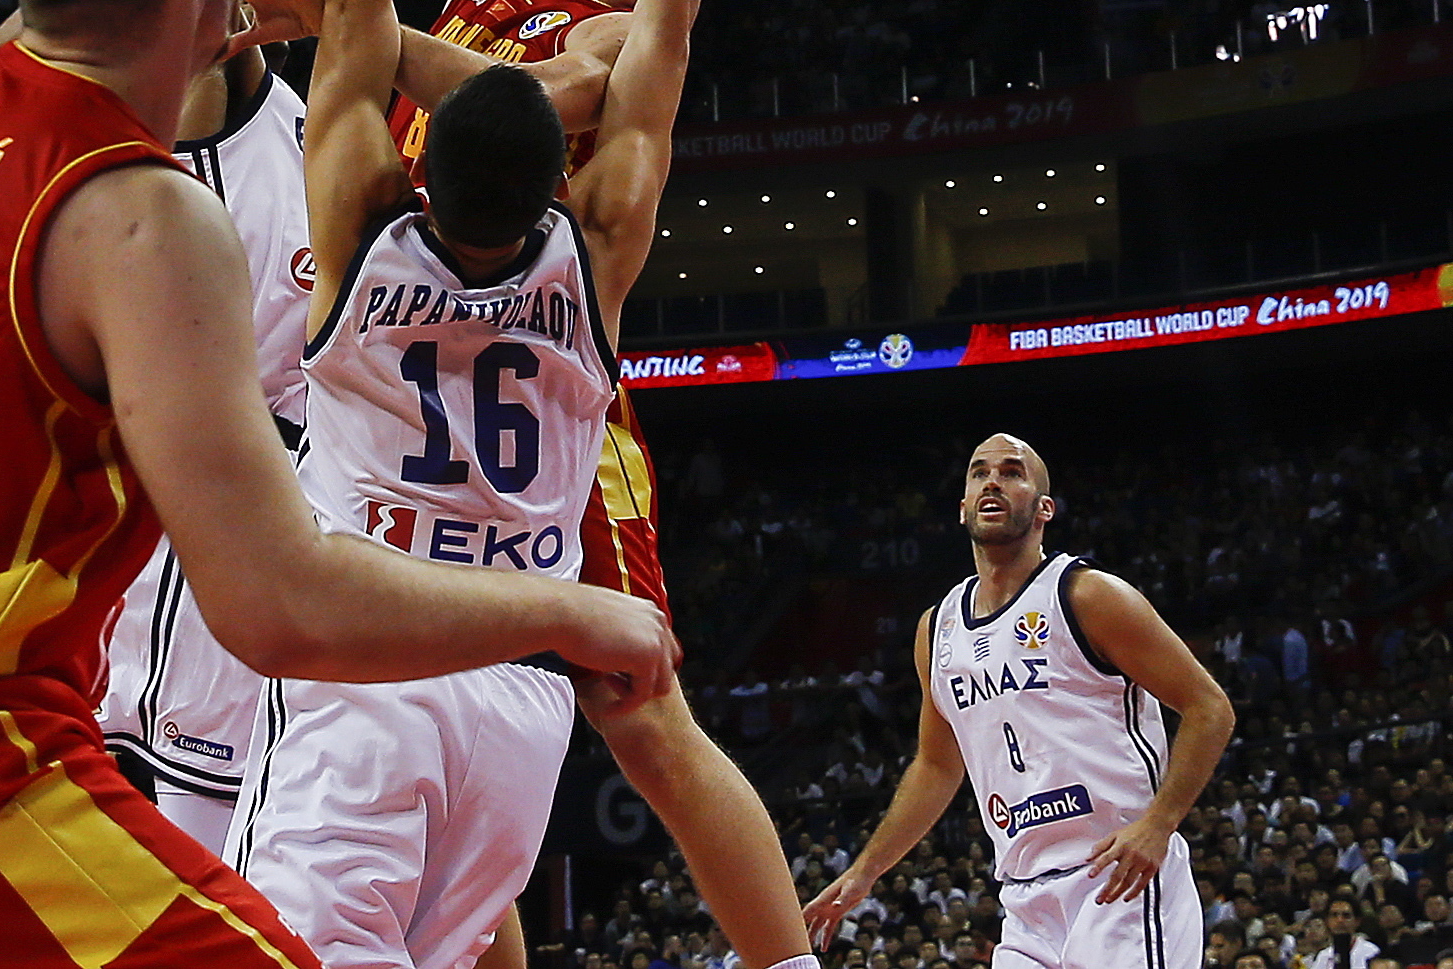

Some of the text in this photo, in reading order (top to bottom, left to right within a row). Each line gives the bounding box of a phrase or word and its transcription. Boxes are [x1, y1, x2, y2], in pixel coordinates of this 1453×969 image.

[674, 94, 1074, 158] KETBALL WORLD CUP China 2019
[1010, 281, 1390, 351] FIBA BASKETBALL WORLD CUP China 2019
[620, 354, 705, 381] ANTING
[399, 340, 541, 495] 16
[429, 518, 564, 571] EKO
[861, 537, 920, 569] 210
[179, 737, 229, 759] Eurobank
